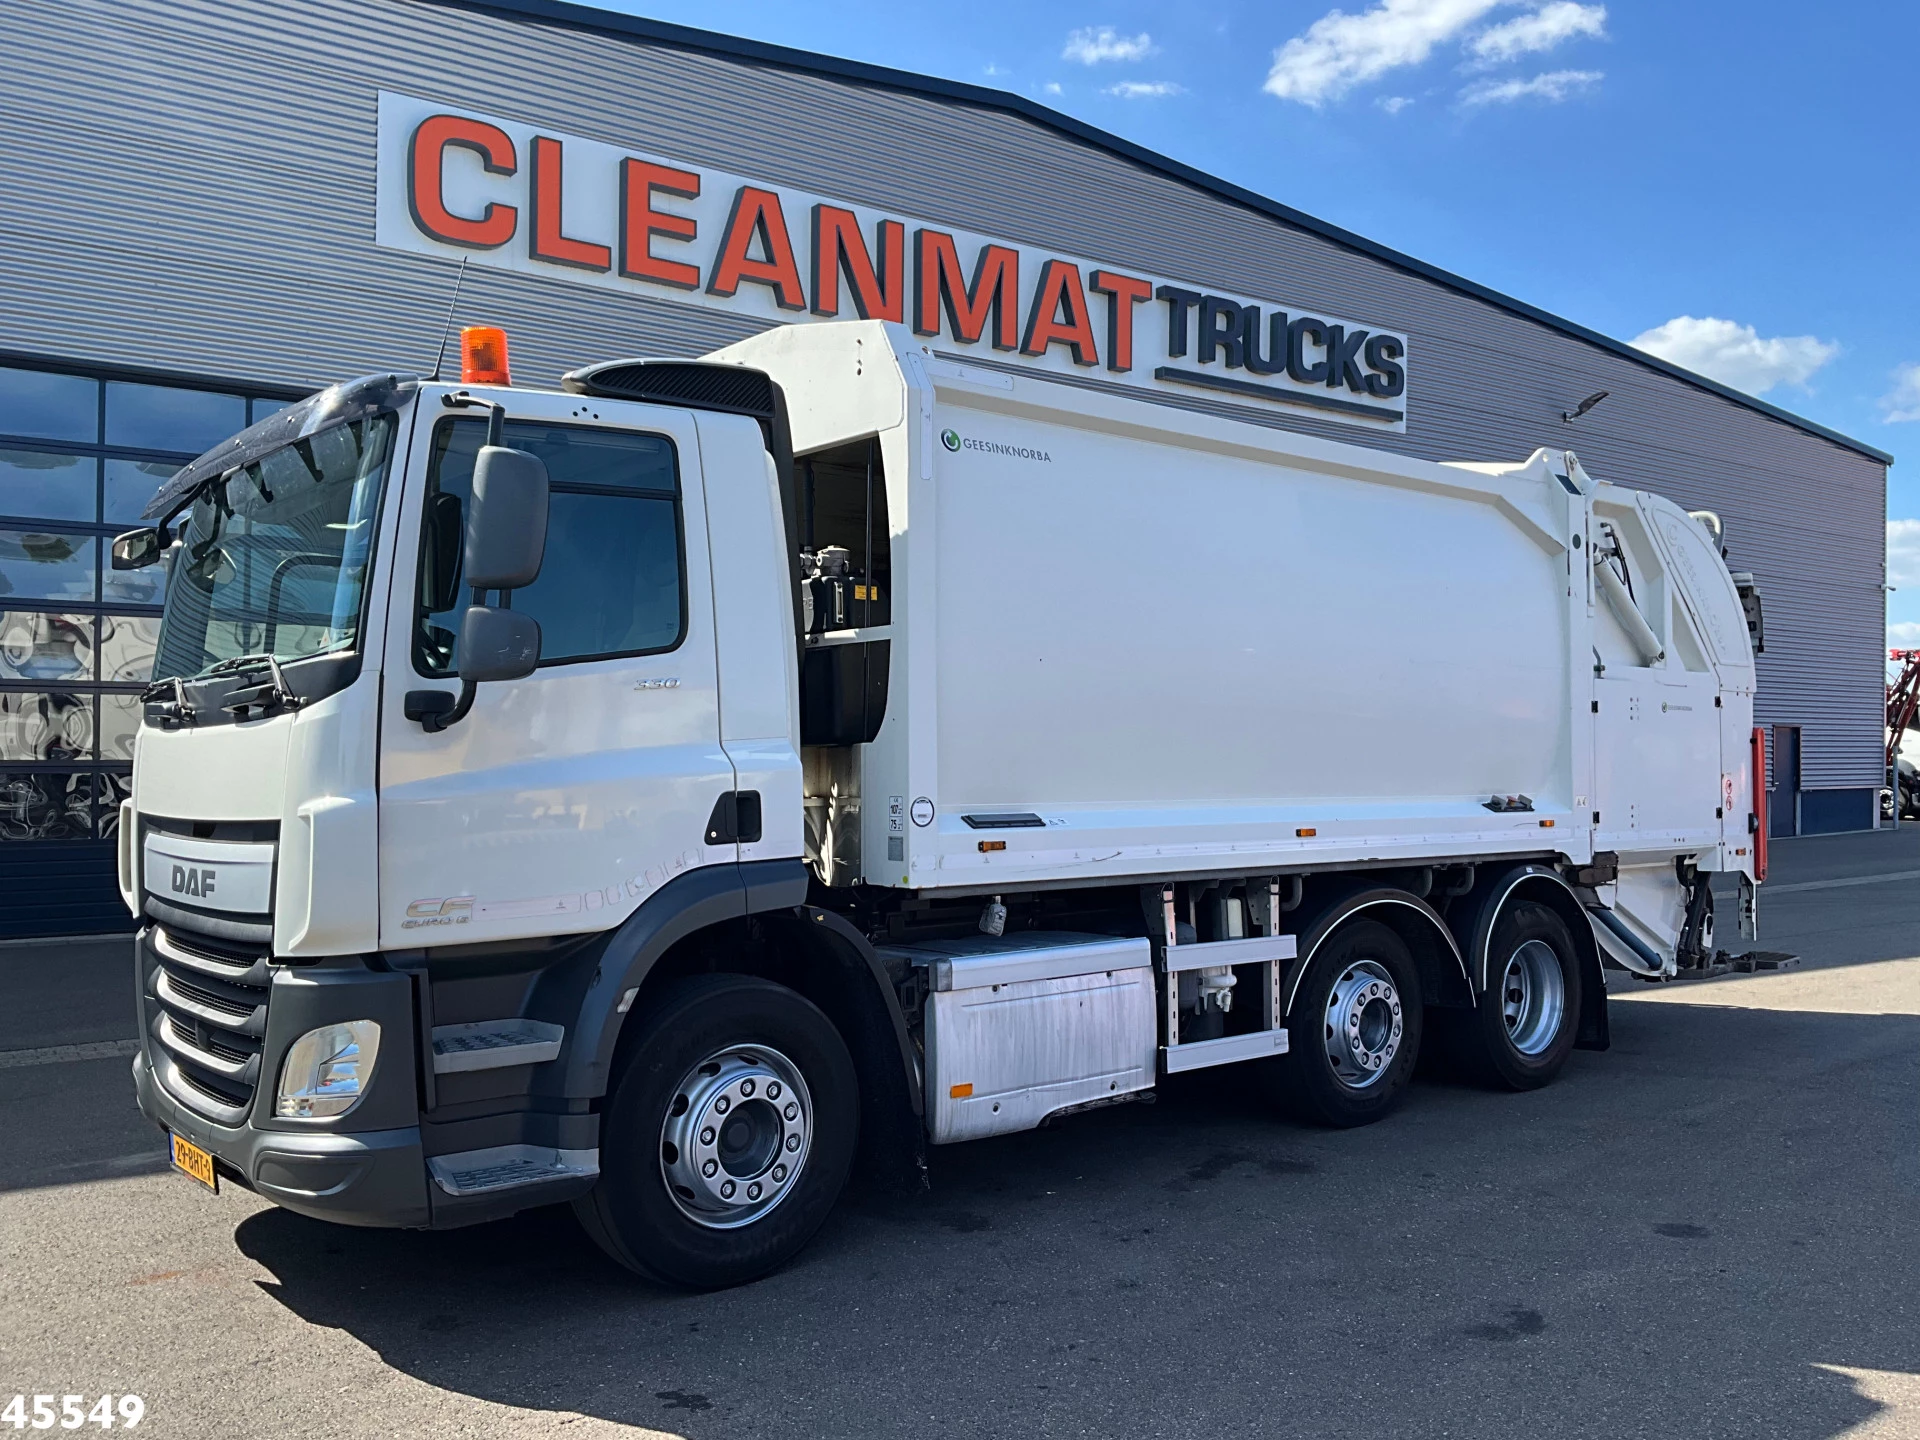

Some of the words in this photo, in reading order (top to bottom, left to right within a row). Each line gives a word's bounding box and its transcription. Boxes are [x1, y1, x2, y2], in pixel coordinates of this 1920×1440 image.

[407, 113, 1152, 373] CLEANMAT
[1156, 285, 1405, 398] TRUCKS
[963, 438, 1052, 462] GEESINKNORBA
[634, 678, 681, 690] 330
[171, 864, 216, 898] DAF
[406, 895, 477, 917] CF
